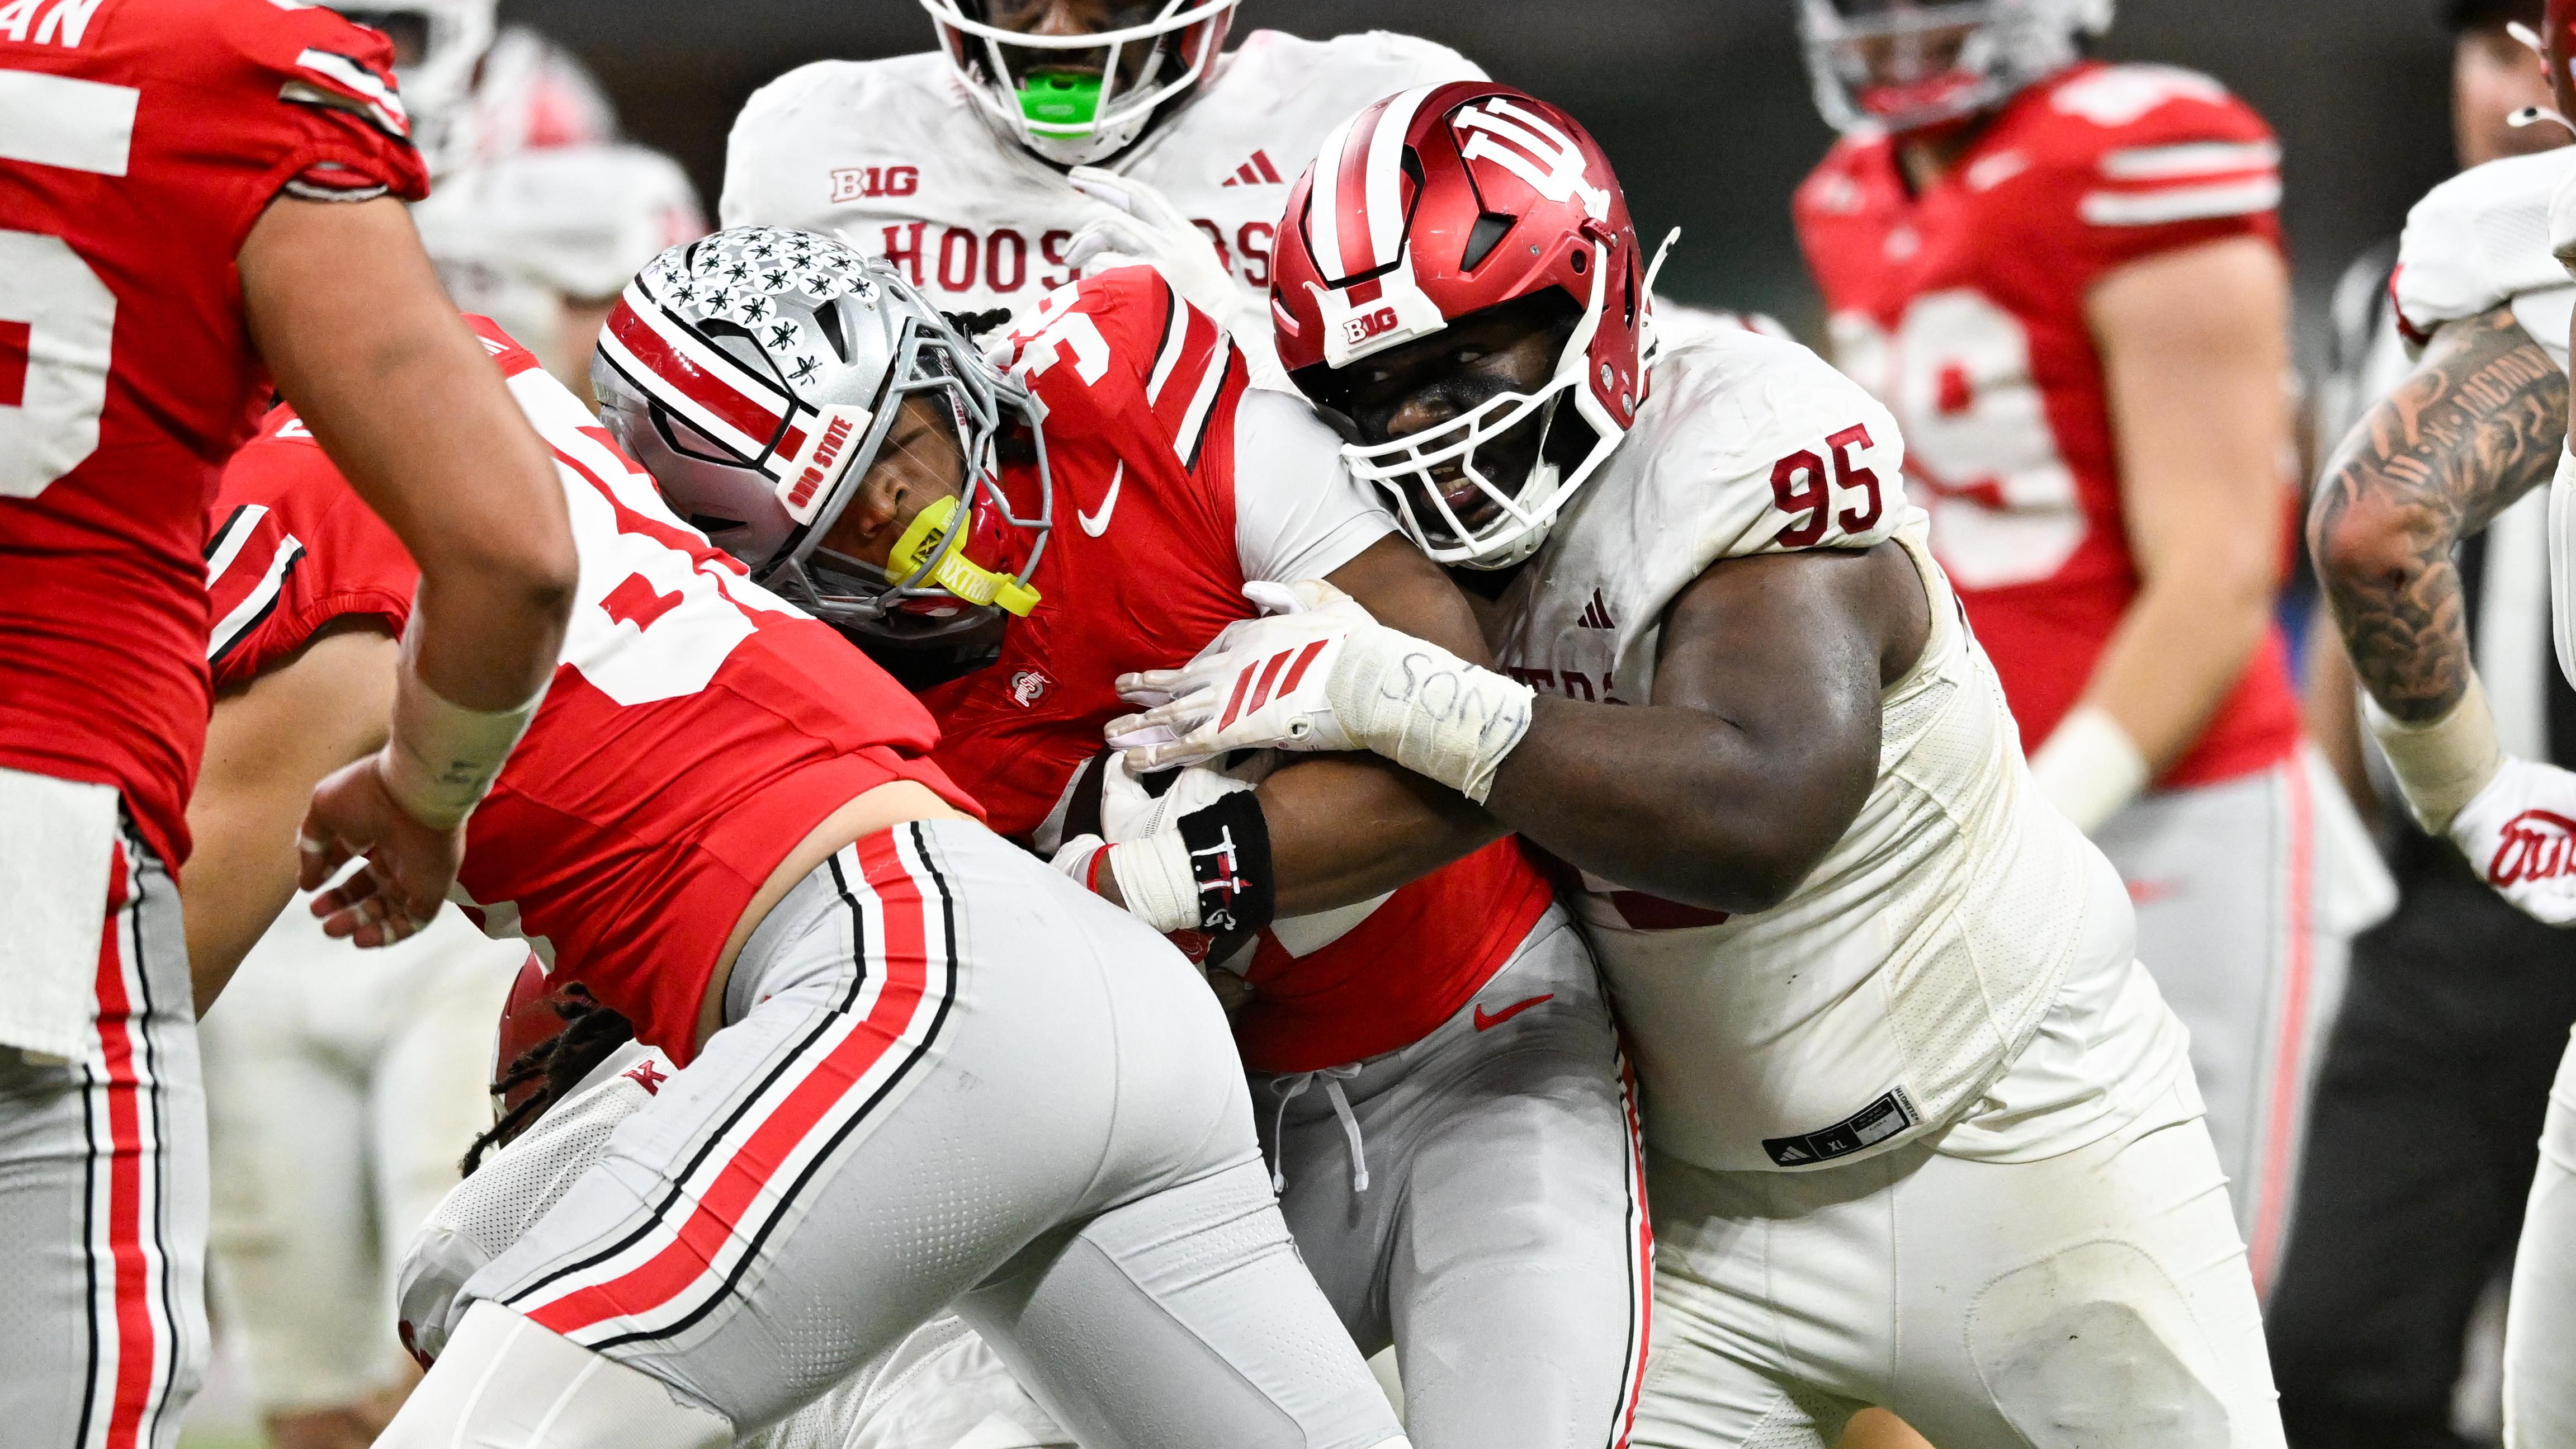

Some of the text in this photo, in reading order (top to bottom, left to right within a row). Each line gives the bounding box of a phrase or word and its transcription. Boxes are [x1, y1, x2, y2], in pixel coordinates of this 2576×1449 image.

[788, 414, 854, 509] OHIO STATE
[1770, 423, 1883, 547] 95
[1827, 1139, 1847, 1152] XL
